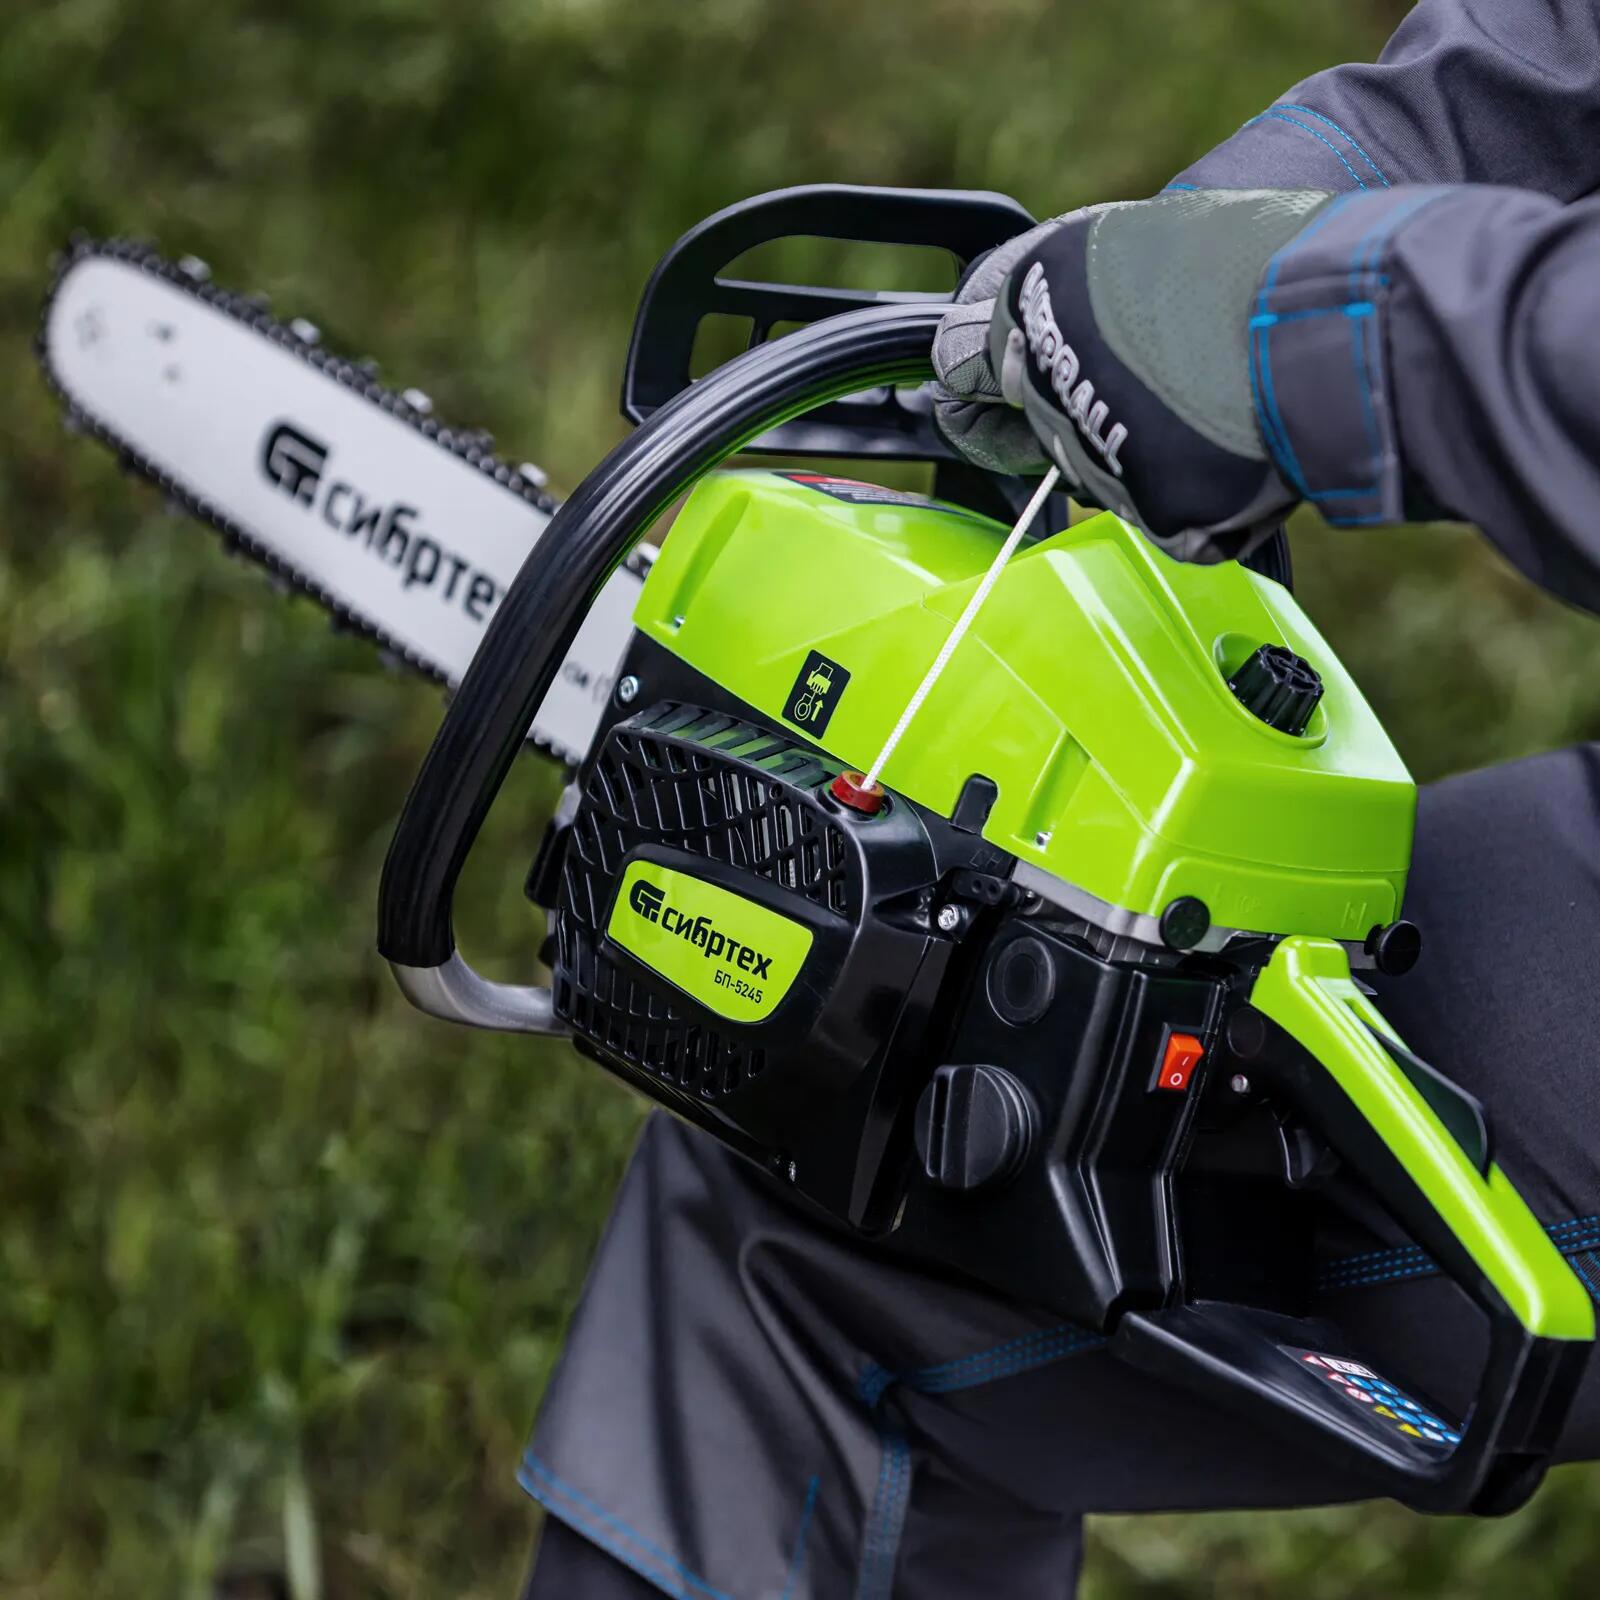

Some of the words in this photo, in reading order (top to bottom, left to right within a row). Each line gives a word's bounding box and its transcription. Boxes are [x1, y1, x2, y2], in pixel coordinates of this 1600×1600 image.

[320, 482, 508, 623] сибрте
[661, 906, 773, 981] сибртех
[714, 970, 763, 1004] БП-5245
